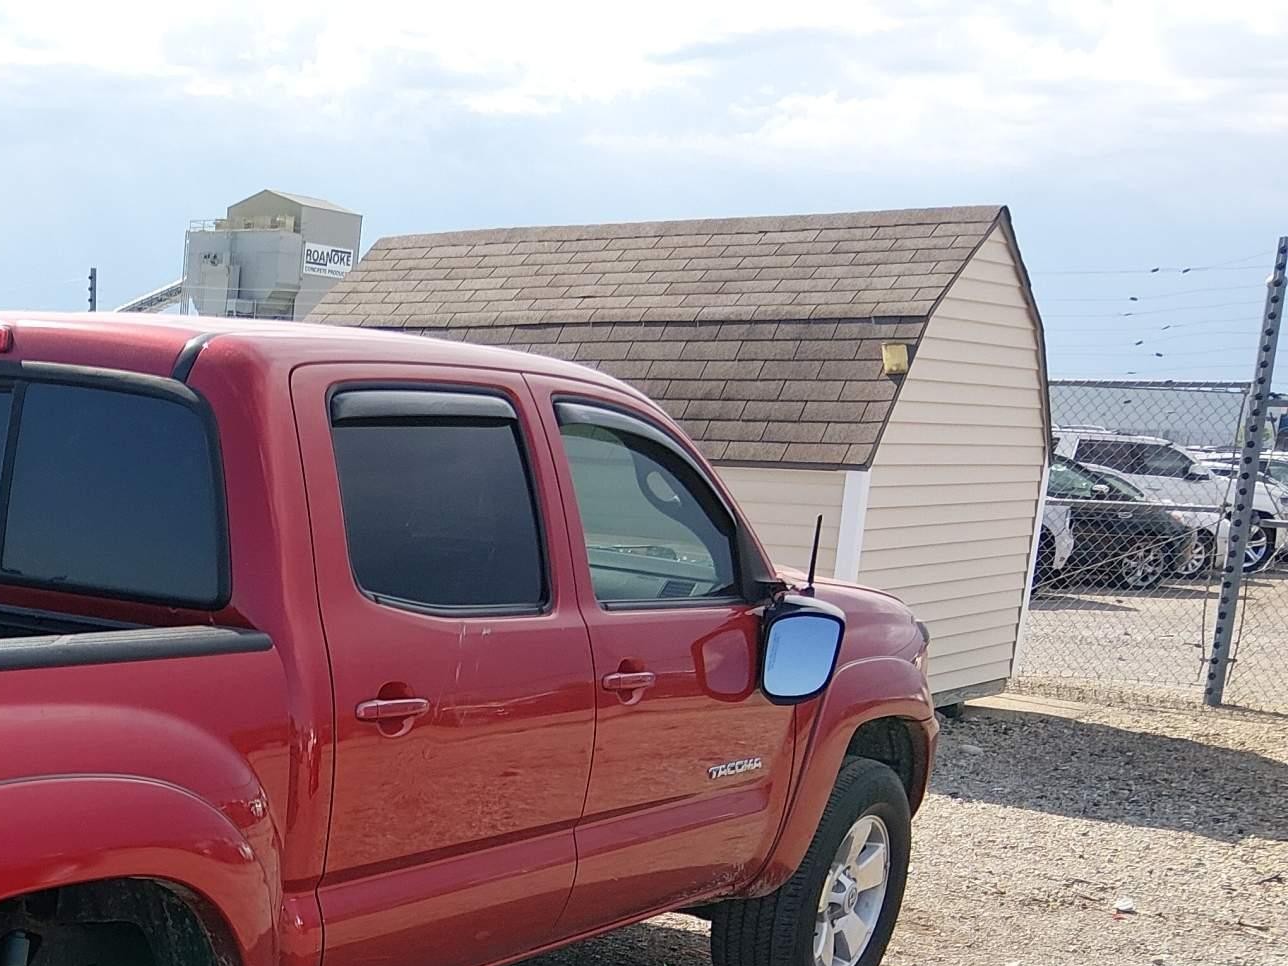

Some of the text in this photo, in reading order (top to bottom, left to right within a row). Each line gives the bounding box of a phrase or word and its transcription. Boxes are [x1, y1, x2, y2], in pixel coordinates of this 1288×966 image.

[306, 249, 351, 267] ROANOKE
[328, 269, 344, 277] PRODUC
[708, 757, 762, 779] TACOMA
